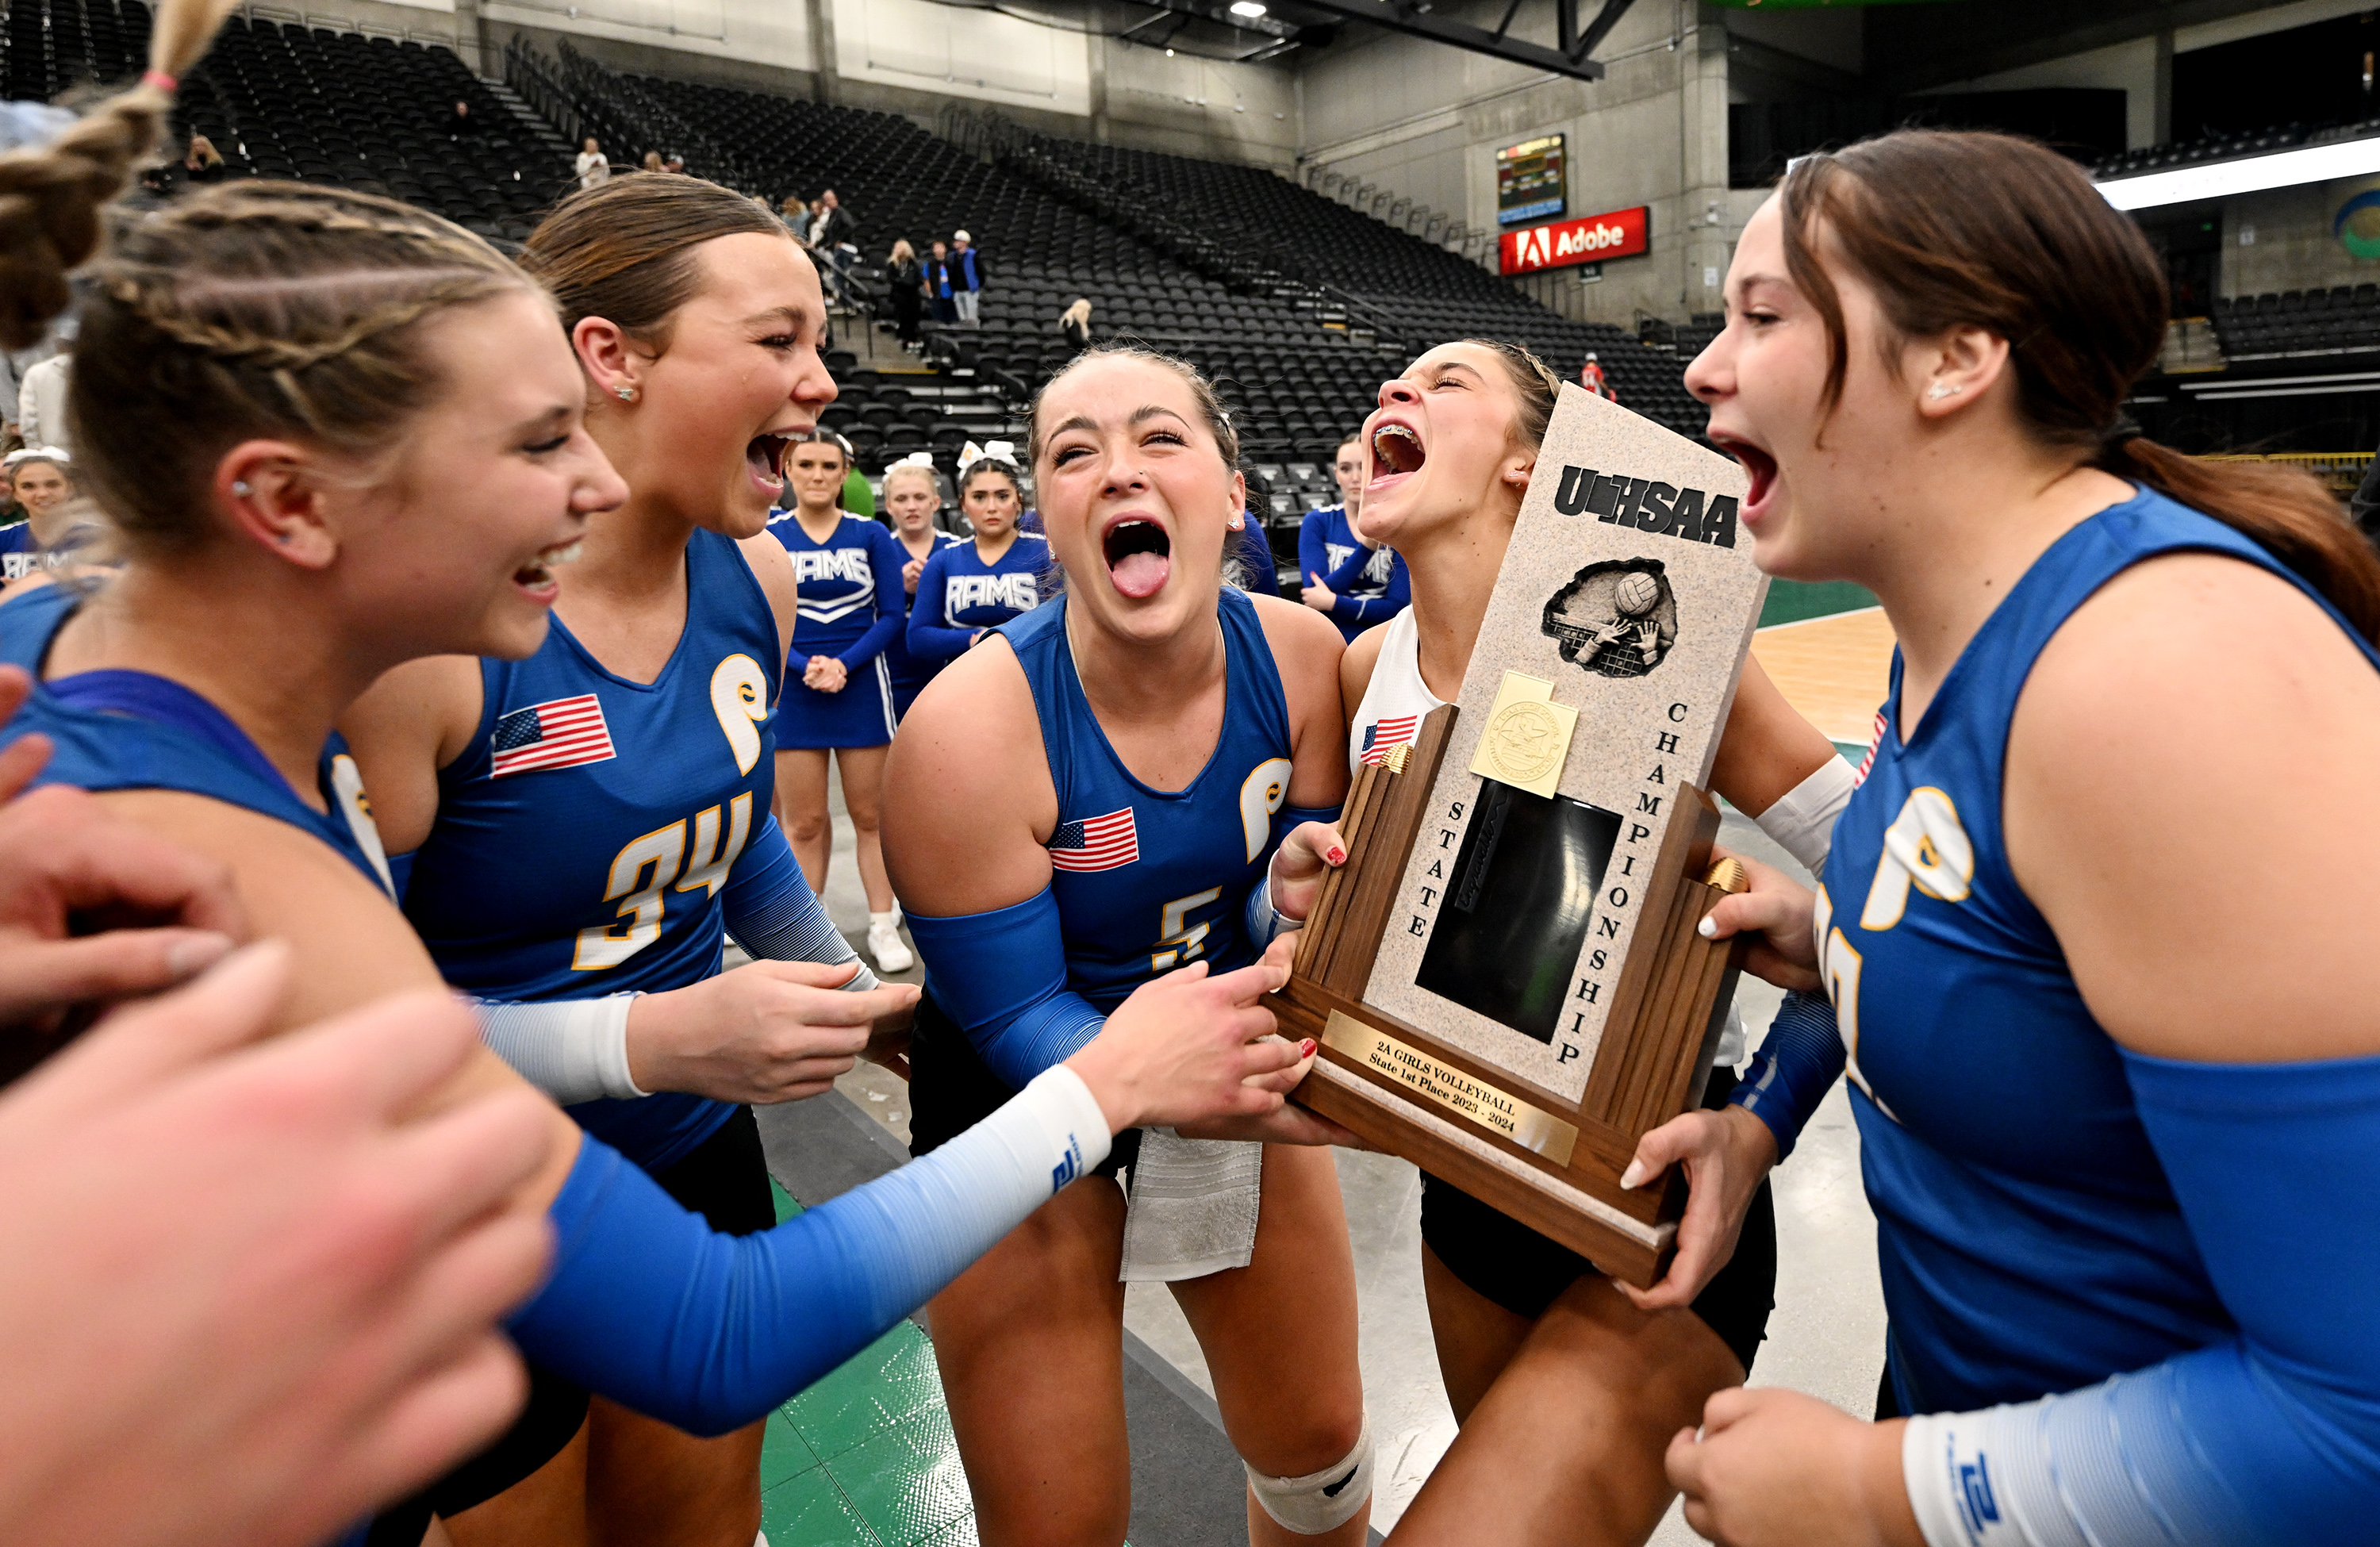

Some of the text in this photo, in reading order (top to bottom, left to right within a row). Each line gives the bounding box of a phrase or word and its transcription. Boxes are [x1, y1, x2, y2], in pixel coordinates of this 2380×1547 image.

[1556, 222, 1624, 256] Adobe
[1553, 465, 1738, 549] UHSAA
[2, 551, 70, 581] RAM
[945, 572, 1039, 616] RAMS
[571, 790, 753, 971] 34
[1407, 801, 1464, 938] STATE
[1557, 702, 1689, 1066] CHAMPIONSHIP
[1369, 1053, 1398, 1075] State
[1400, 1068, 1417, 1084] 1st
[1418, 1077, 1450, 1102] Place
[1452, 1093, 1479, 1114] 2023
[1488, 1112, 1515, 1133] 2024
[1376, 1041, 1515, 1115] 2A GIRLS VOLLEYBALL
